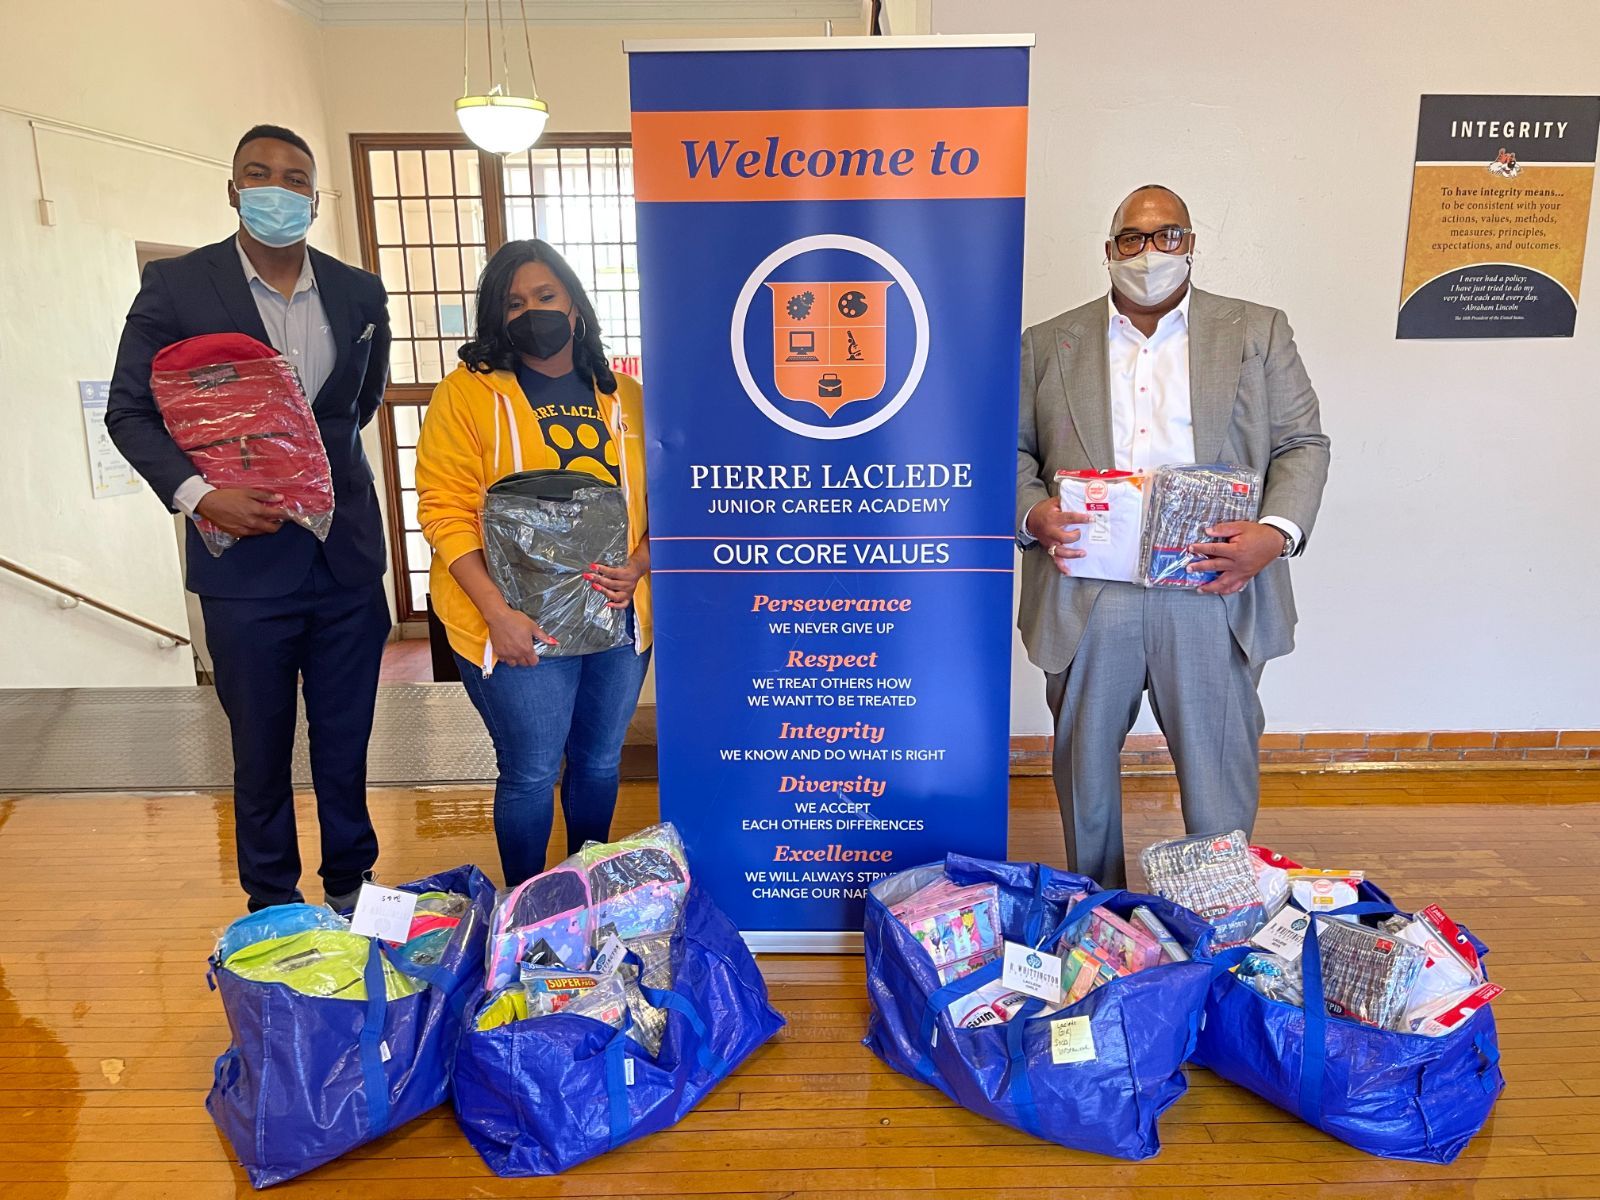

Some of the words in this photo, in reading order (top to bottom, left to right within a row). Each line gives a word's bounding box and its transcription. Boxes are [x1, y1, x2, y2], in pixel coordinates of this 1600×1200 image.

[1451, 120, 1568, 138] INTEGRITY
[681, 136, 915, 179] Welcome
[930, 141, 980, 176] to
[1441, 187, 1453, 196] To
[1455, 187, 1478, 196] have
[1480, 187, 1522, 199] integrity
[1524, 189, 1565, 197] means...
[1441, 202, 1451, 210] to
[1453, 201, 1465, 210] be
[1466, 201, 1514, 210] consistent
[1516, 201, 1537, 210] with
[1539, 203, 1562, 212] your
[1441, 214, 1478, 223] actions,
[1481, 214, 1512, 223] values,
[1514, 214, 1557, 224] methods,
[1431, 242, 1493, 252] expectations,
[1495, 241, 1512, 250] and
[1515, 242, 1561, 250] outcomes.
[1504, 274, 1528, 284] policy;
[1471, 285, 1486, 293] just
[1513, 283, 1522, 291] do
[1474, 293, 1490, 301] each
[1491, 293, 1505, 301] and
[1524, 293, 1539, 302] day.
[612, 357, 639, 377] EXIT
[690, 465, 811, 489] PIERRE
[822, 464, 972, 489] LACLEDE
[708, 499, 775, 514] JUNIOR
[782, 499, 852, 514] CAREER
[858, 498, 950, 513] ACADEMY
[713, 543, 768, 565] OUR
[776, 543, 847, 565] CORE
[853, 543, 950, 564] VALUES
[751, 595, 912, 612] Perseverance
[769, 622, 791, 634] WE
[795, 622, 838, 634] NEVER
[842, 622, 872, 634] GIVE
[877, 622, 895, 634] UP
[786, 650, 878, 671] Respect
[752, 678, 774, 689] WE
[777, 678, 818, 689] TREAT
[820, 677, 873, 689] OTHERS
[876, 677, 912, 689] HOW
[747, 695, 769, 707] WE
[772, 695, 813, 707] WANT
[815, 695, 834, 707] TO
[838, 695, 854, 707] BE
[857, 695, 917, 707] TREATED
[778, 721, 885, 744] Integrity
[720, 750, 742, 761] WE
[745, 750, 788, 761] KNOW
[791, 749, 821, 760] AND
[825, 749, 846, 760] DO
[849, 750, 888, 760] WHAT
[892, 749, 903, 760] IS
[906, 749, 946, 760] RIGHT
[778, 775, 887, 798] Diversity
[794, 803, 816, 814] WE
[819, 803, 871, 814] ACCEPT
[742, 819, 778, 831] EACH
[782, 819, 833, 831] OTHERS
[836, 819, 925, 831] DIFFERENCES
[773, 845, 893, 863] Excellence
[745, 871, 766, 883] WE
[769, 871, 799, 883] WILL
[801, 871, 854, 883] ALWAYS
[857, 871, 897, 882] STRI
[752, 887, 809, 899] CHANGE
[812, 887, 841, 899] OUR
[1201, 907, 1227, 917] CUPID
[548, 978, 581, 989] SUPER
